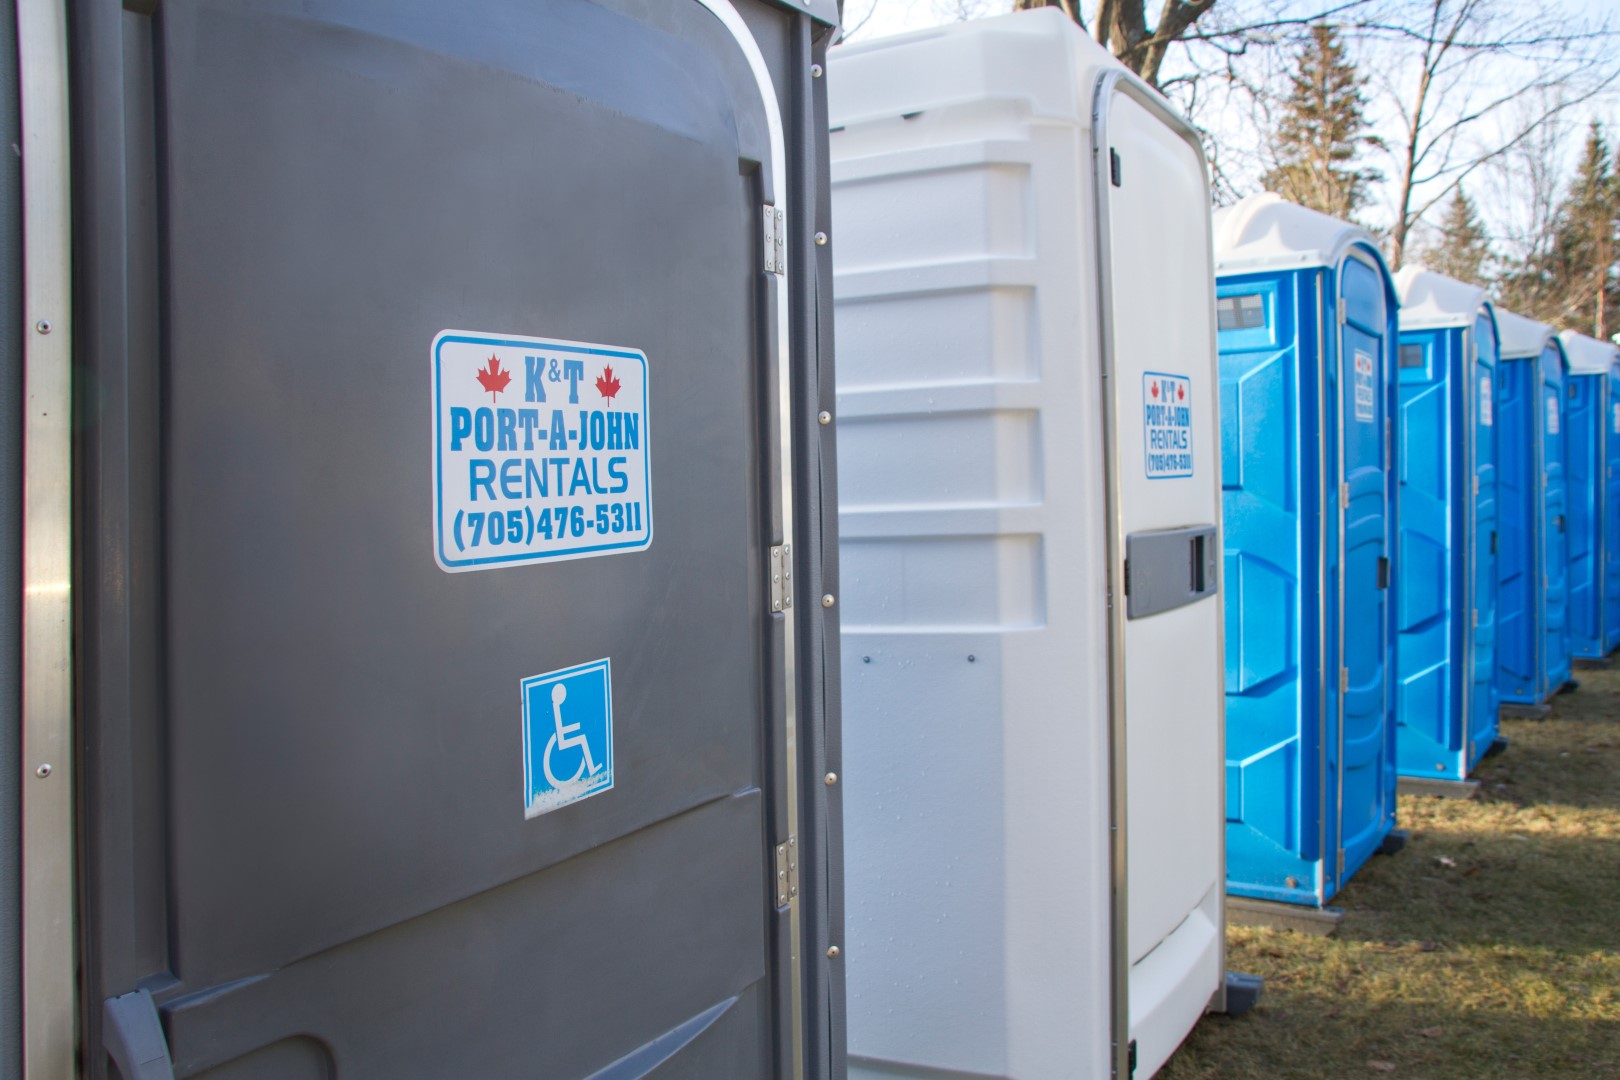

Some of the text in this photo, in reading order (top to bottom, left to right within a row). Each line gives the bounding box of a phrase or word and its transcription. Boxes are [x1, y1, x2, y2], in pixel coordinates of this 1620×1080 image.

[525, 356, 584, 404] K&T
[450, 407, 639, 451] PORT-A-JOHN
[1150, 429, 1187, 449] RENTALS
[469, 457, 629, 501] RENTALS
[453, 502, 641, 552] (705)476-5311
